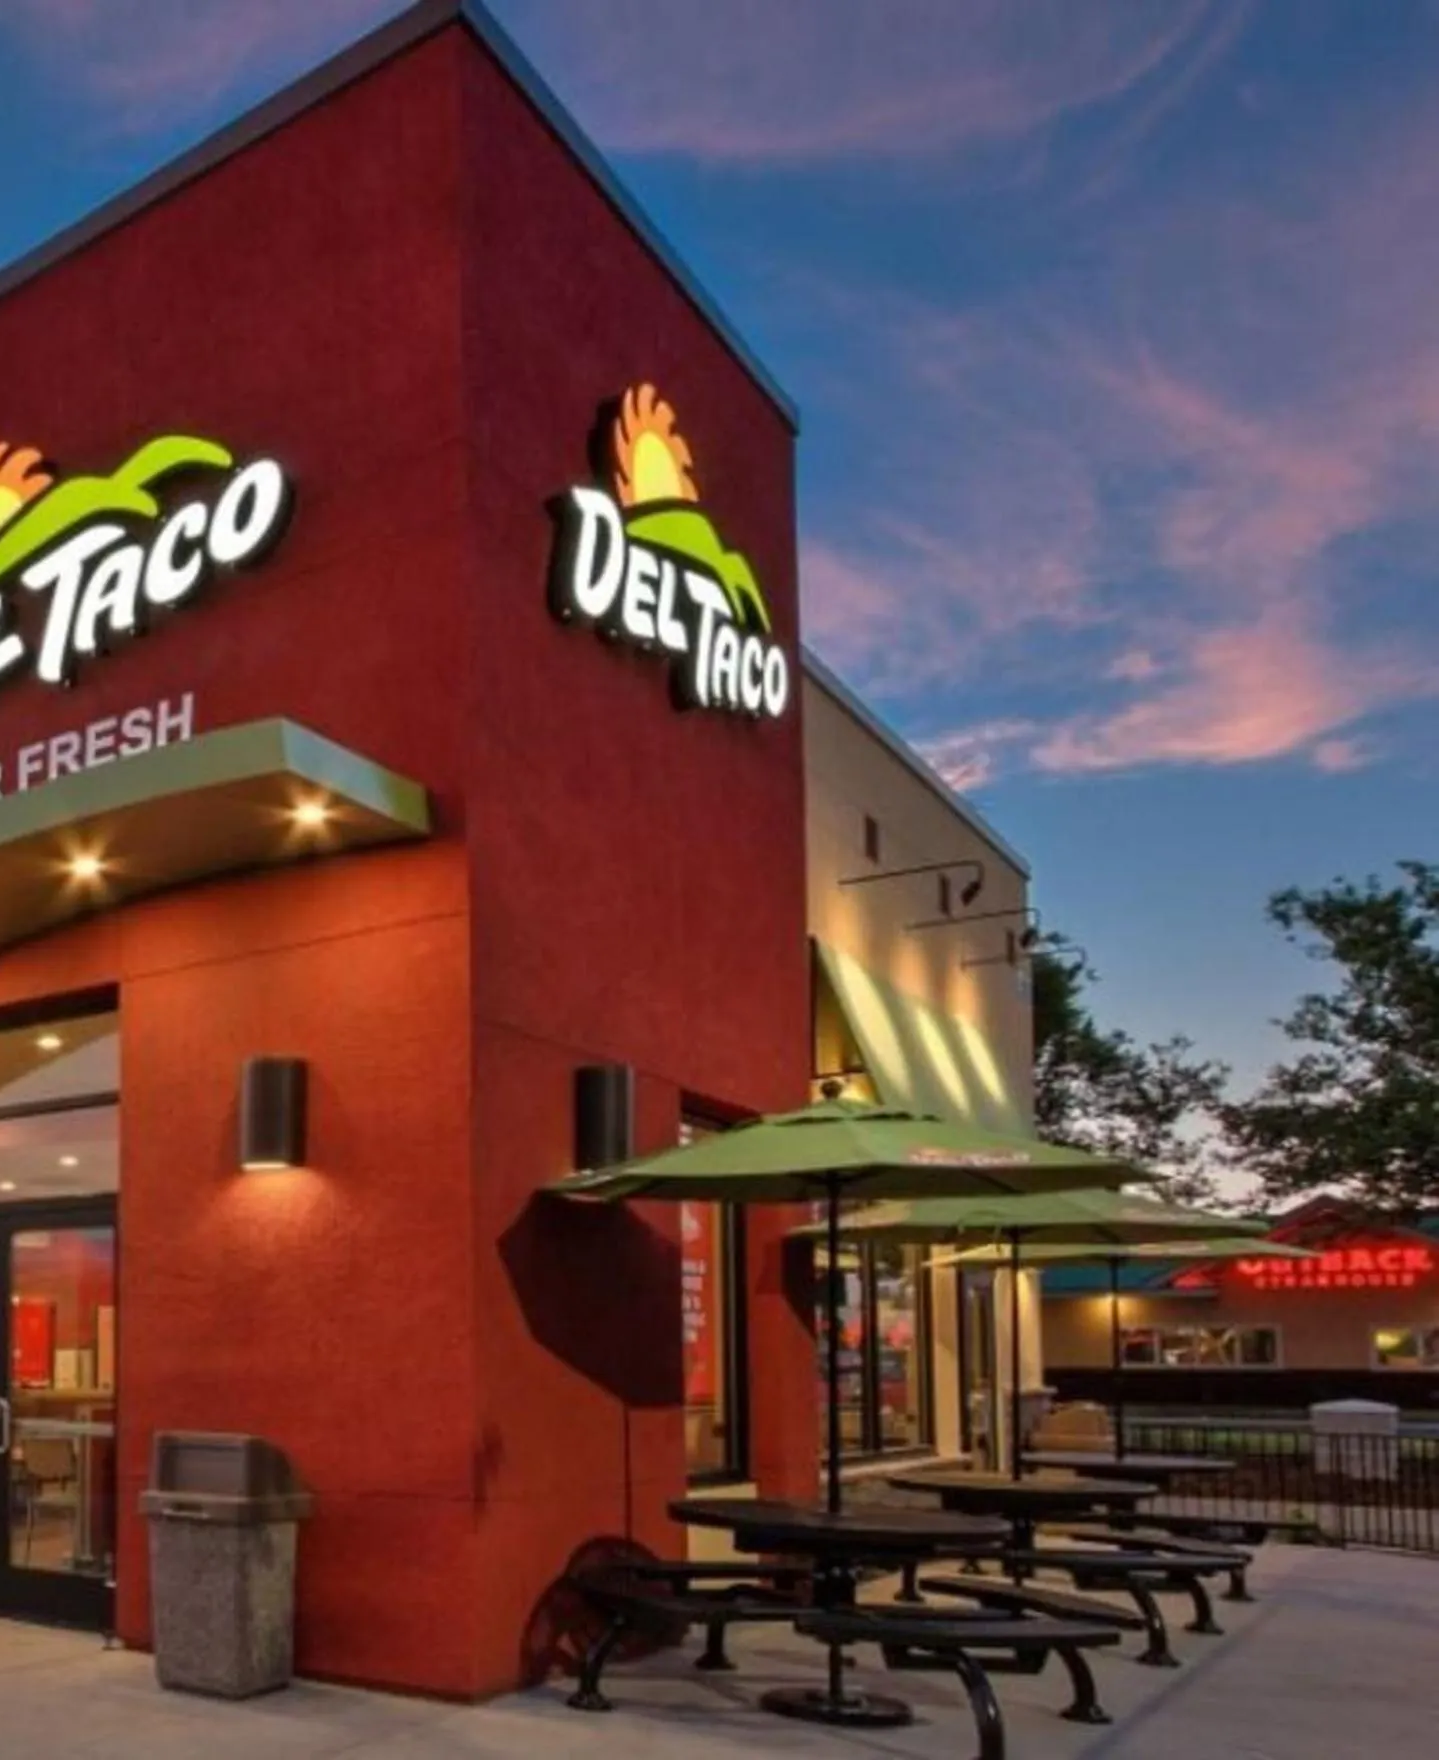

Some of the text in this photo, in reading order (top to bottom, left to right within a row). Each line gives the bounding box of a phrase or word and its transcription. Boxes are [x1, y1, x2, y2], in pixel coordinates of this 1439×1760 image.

[21, 459, 283, 682] TACO
[570, 485, 788, 718] DEL TACO
[17, 692, 194, 792] FRESH
